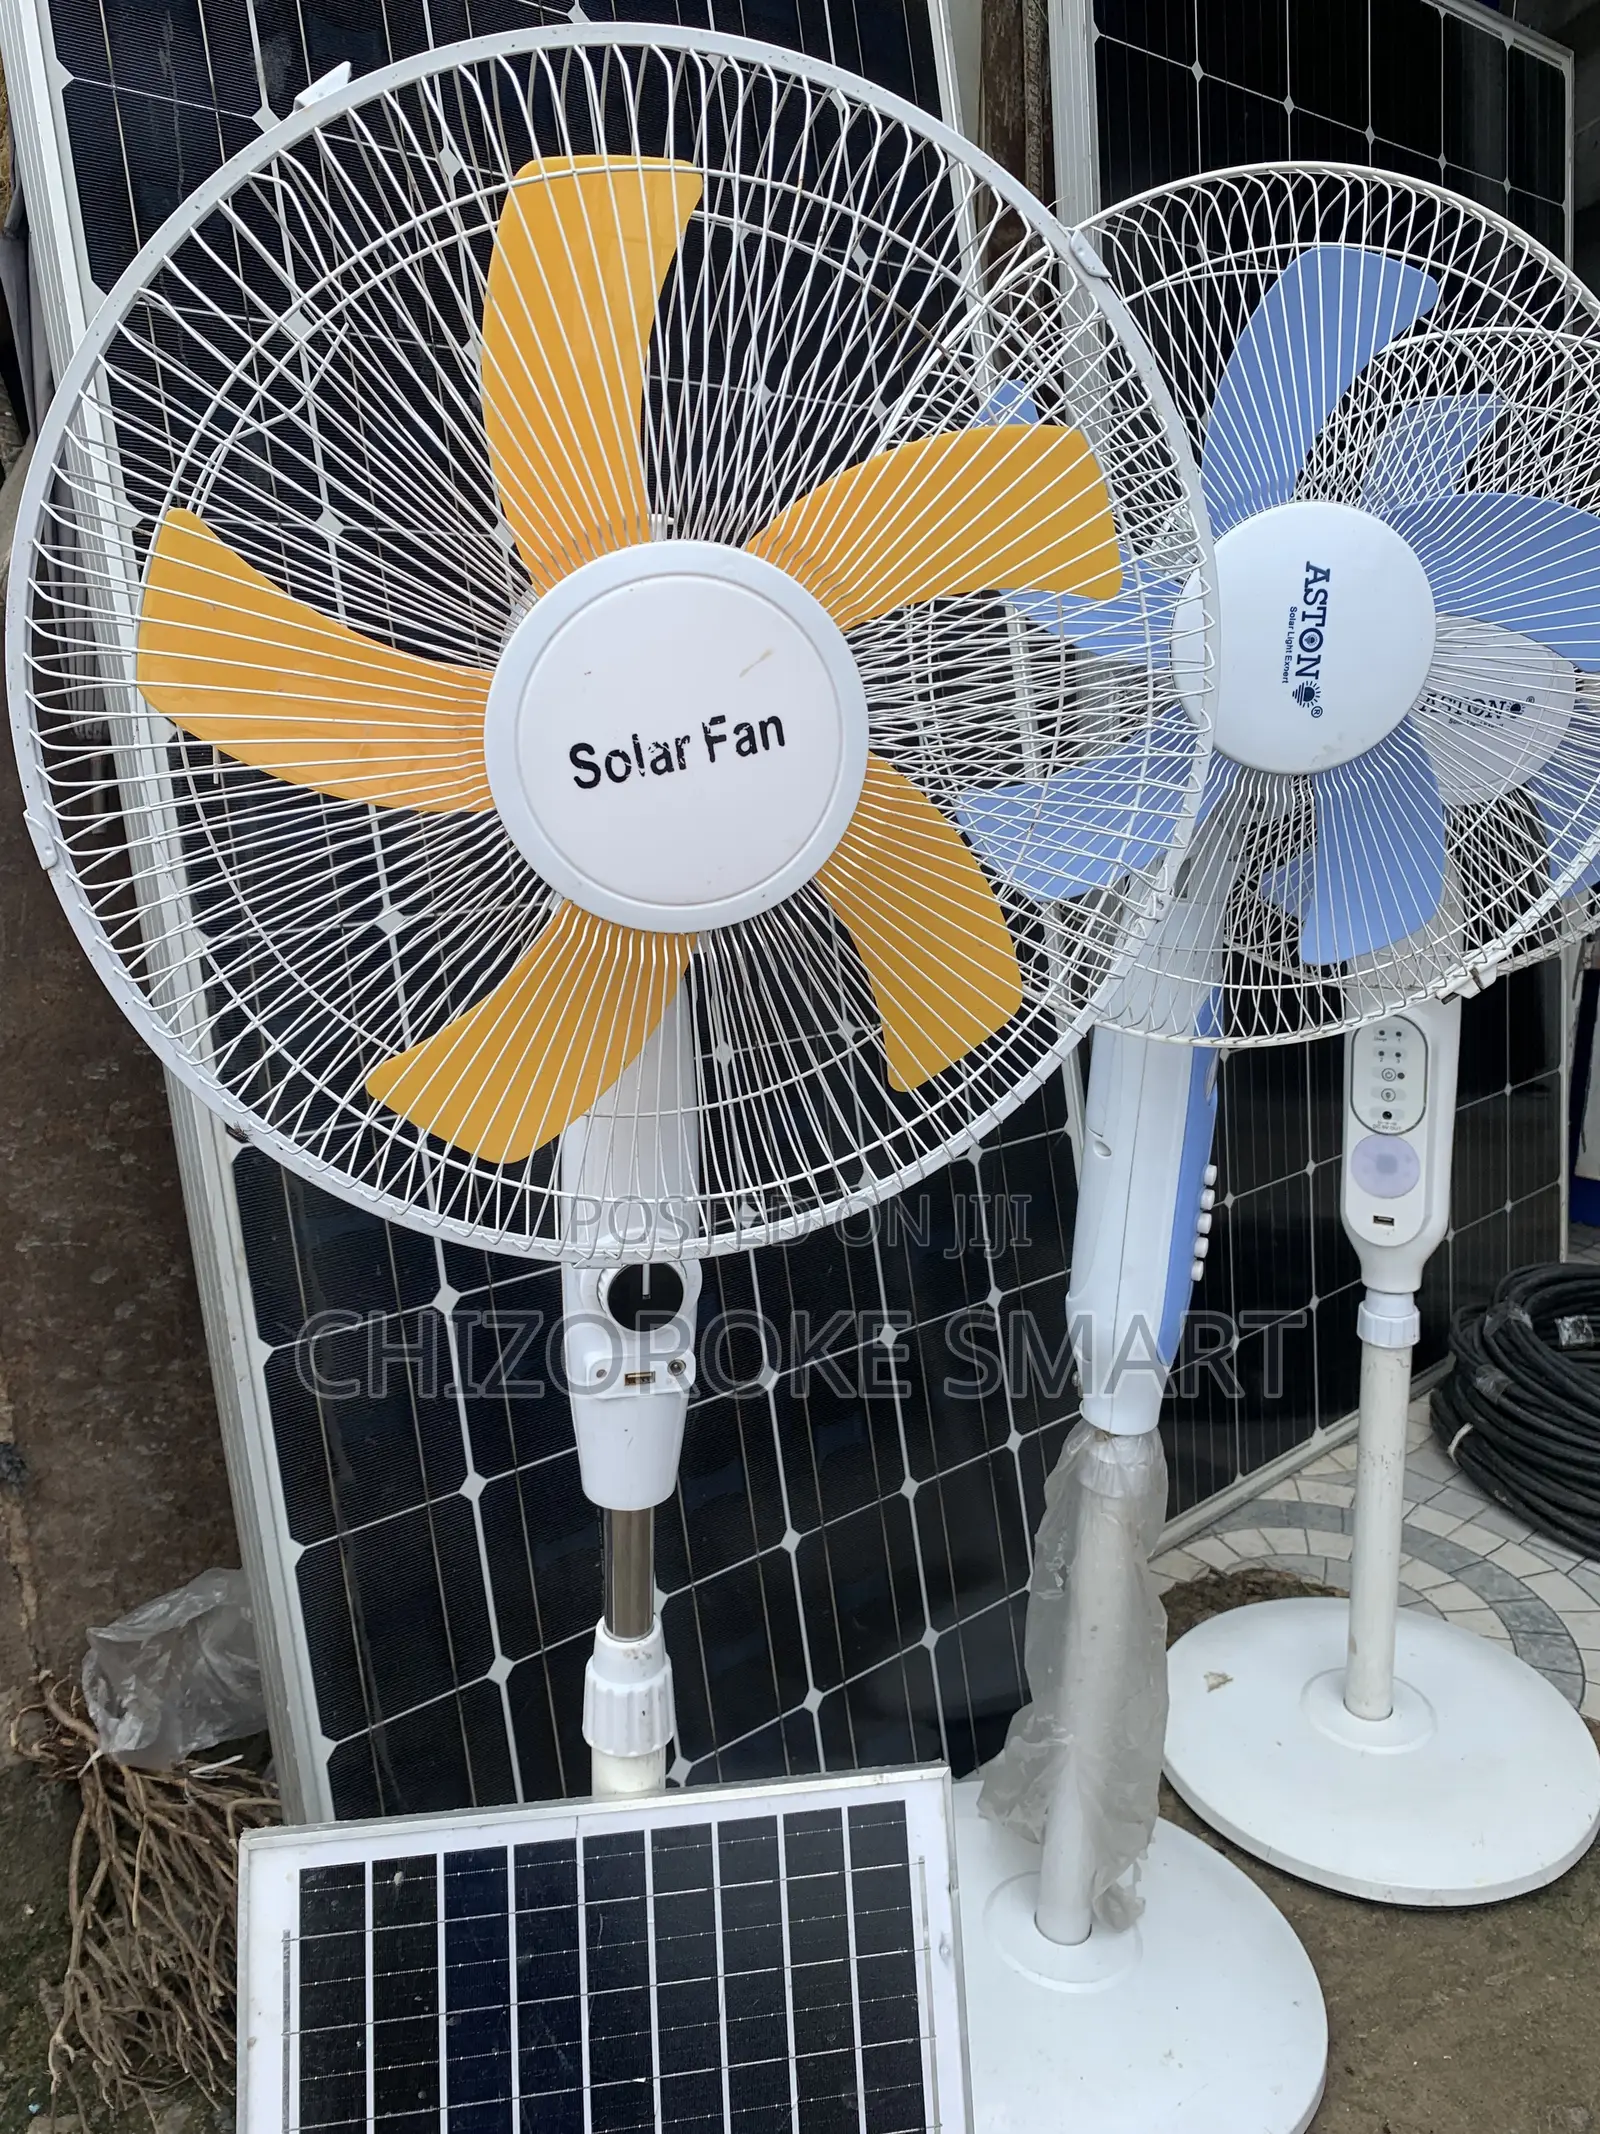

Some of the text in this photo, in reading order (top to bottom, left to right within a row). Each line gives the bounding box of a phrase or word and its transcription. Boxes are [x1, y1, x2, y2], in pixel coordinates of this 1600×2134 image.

[1284, 631, 1296, 654] Light
[1288, 606, 1298, 630] Solar
[1295, 560, 1331, 680] ASTON
[569, 714, 786, 789] Solar Fan
